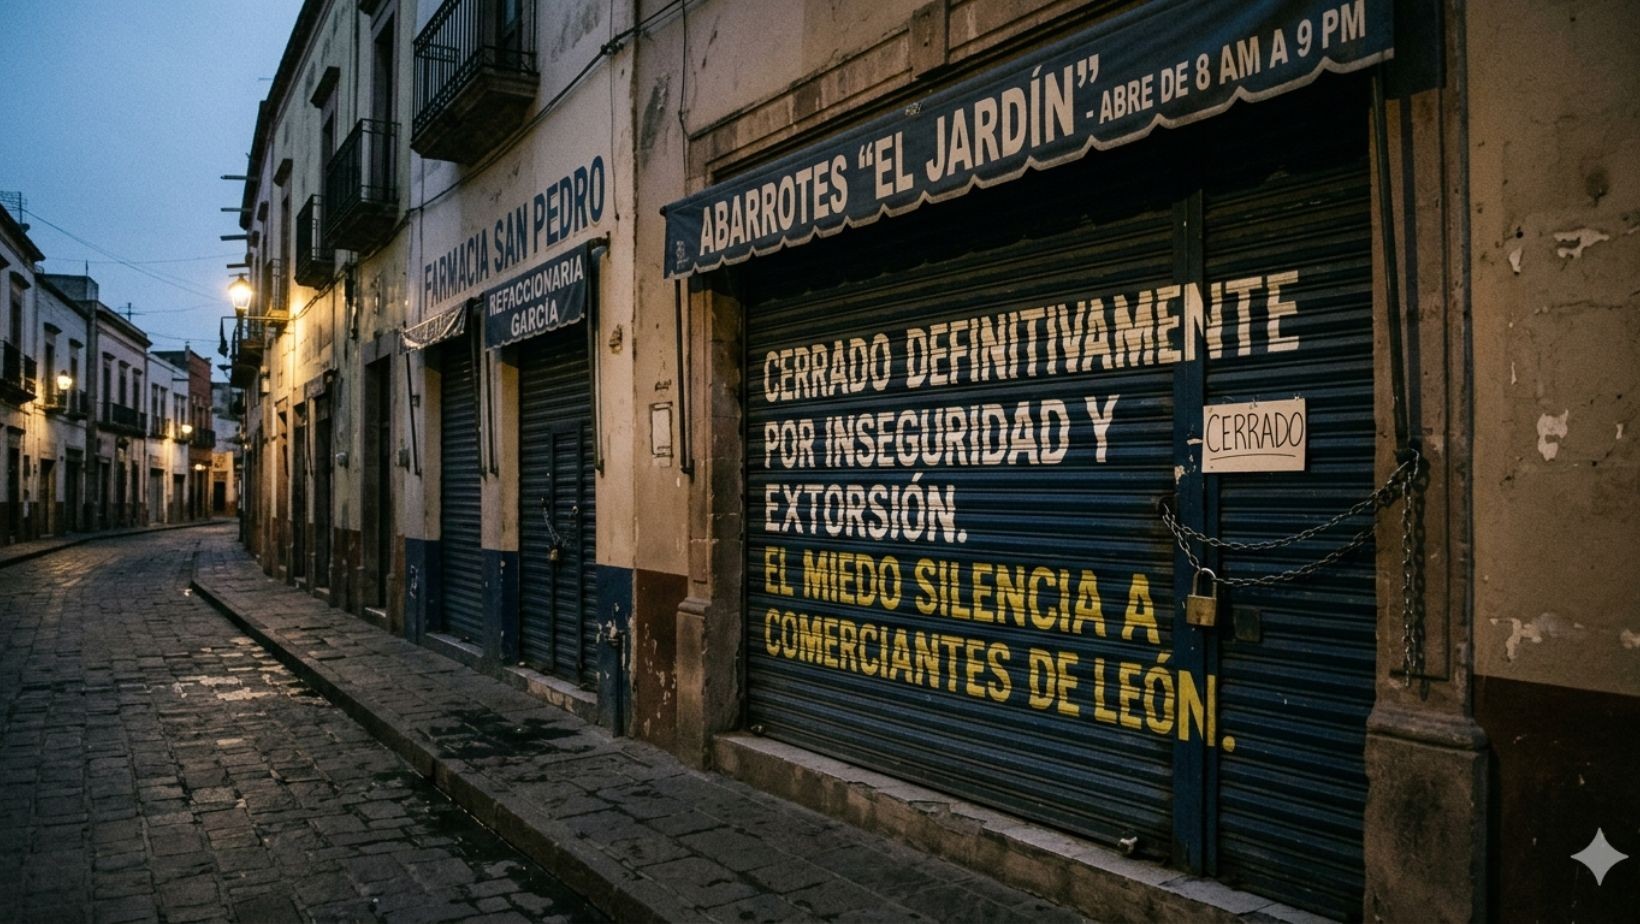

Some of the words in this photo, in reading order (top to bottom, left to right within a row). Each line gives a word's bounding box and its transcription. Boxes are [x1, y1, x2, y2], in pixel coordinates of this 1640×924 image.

[700, 155, 848, 257] ABARROTES
[858, 131, 914, 200] “EL
[926, 53, 1099, 183] JARDÍN”
[1099, 74, 1153, 124] ABRE
[1161, 61, 1189, 104] DE
[1196, 53, 1211, 91] 8
[1219, 36, 1261, 85] AM
[1269, 28, 1289, 69] A
[1297, 19, 1313, 58] 9
[1322, 0, 1366, 49] PM
[424, 229, 489, 314] FARMACIA
[494, 202, 528, 273] SAN
[533, 155, 605, 254] PEDRO
[489, 254, 584, 317] REFACCIONARIA
[511, 297, 559, 337] GARCÍA
[763, 332, 892, 403] CERRADO
[905, 269, 1300, 389] DEFINITIVAMENTE
[763, 419, 815, 469] POR
[824, 398, 1071, 468] INSEGURIDAD
[1084, 394, 1121, 463] Y
[1206, 411, 1304, 453] CERRADO
[764, 472, 968, 543] EXTORSIÓN.
[764, 546, 795, 597] EL
[802, 548, 902, 611] MIEDO
[914, 558, 1106, 637] SILENCIA
[1121, 572, 1160, 645] A
[764, 607, 1012, 702] COMERCIANTES
[1028, 648, 1081, 718] DE
[1092, 652, 1236, 753] LEÓN.
